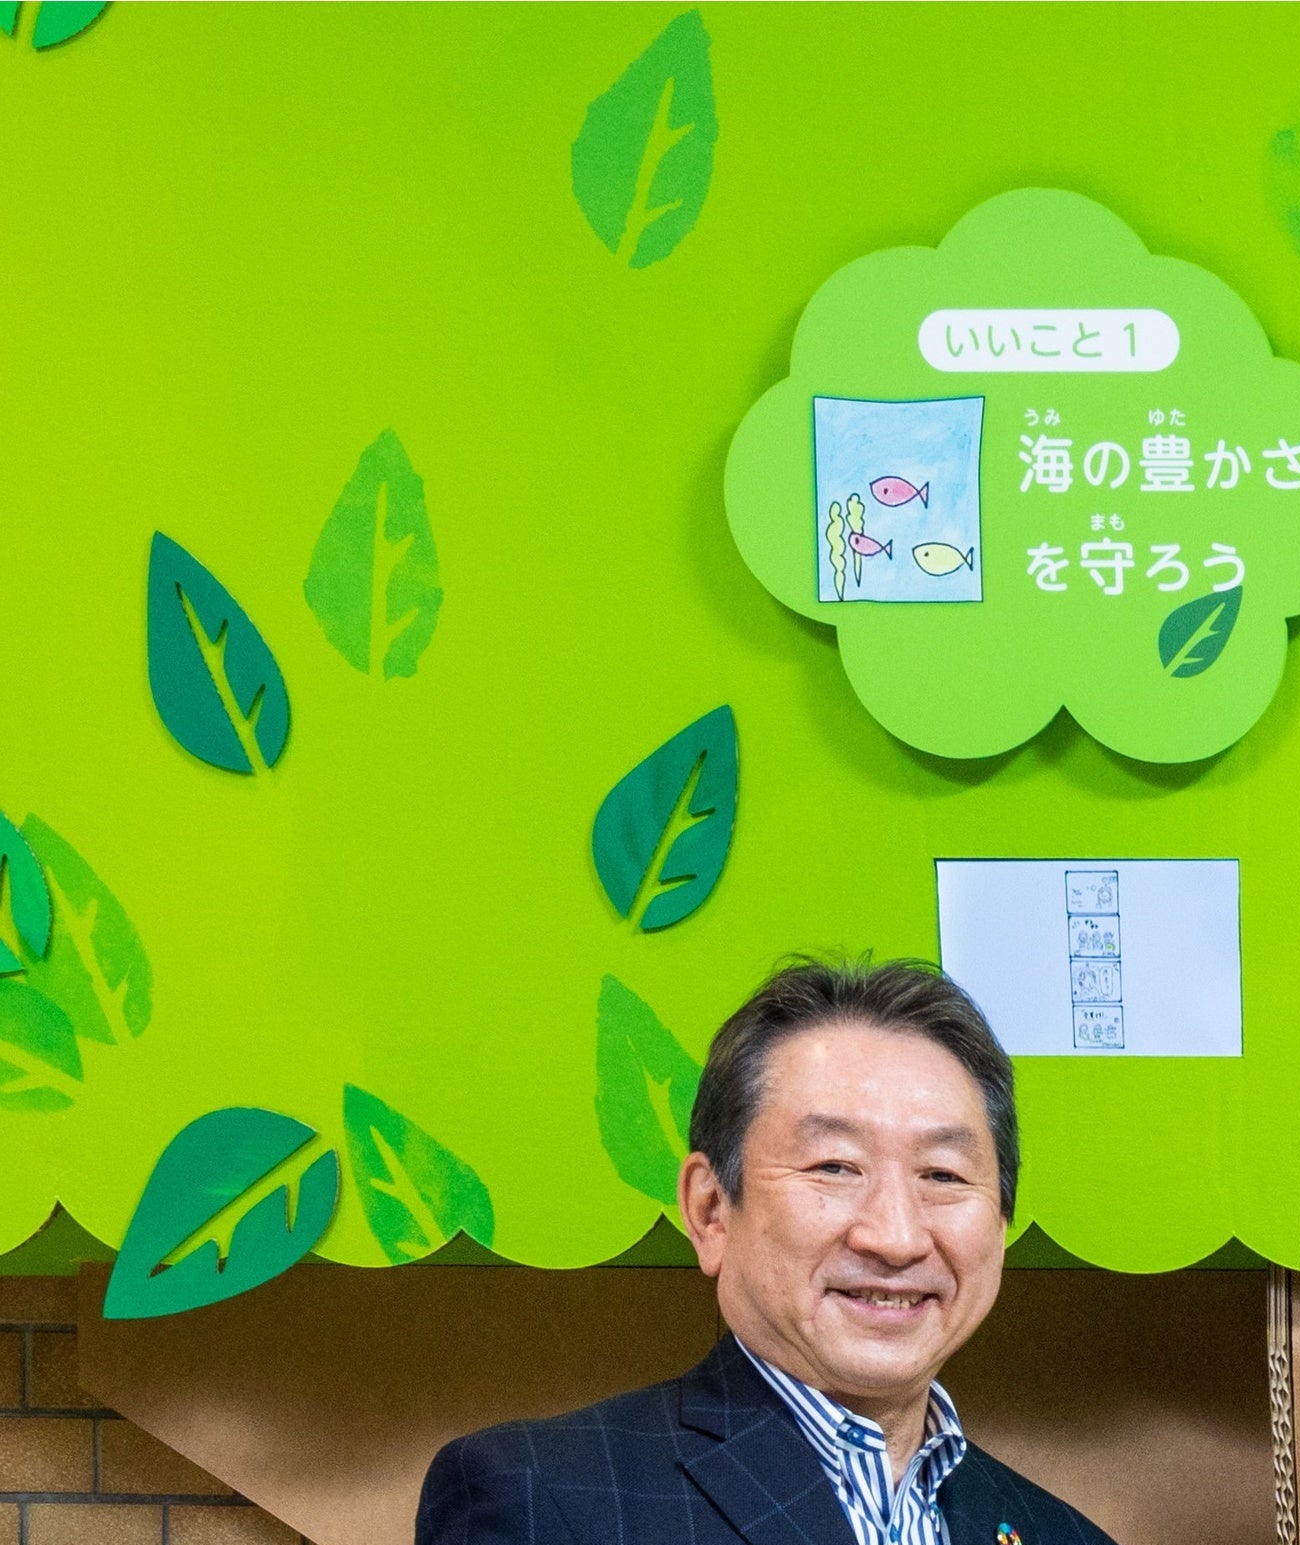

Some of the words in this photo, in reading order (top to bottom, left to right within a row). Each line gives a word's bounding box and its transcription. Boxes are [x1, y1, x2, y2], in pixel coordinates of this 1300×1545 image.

[1023, 408, 1061, 427] うみ
[1148, 408, 1186, 427] ゆた
[1090, 513, 1125, 532] まも
[1026, 536, 1246, 596] を守ろう
